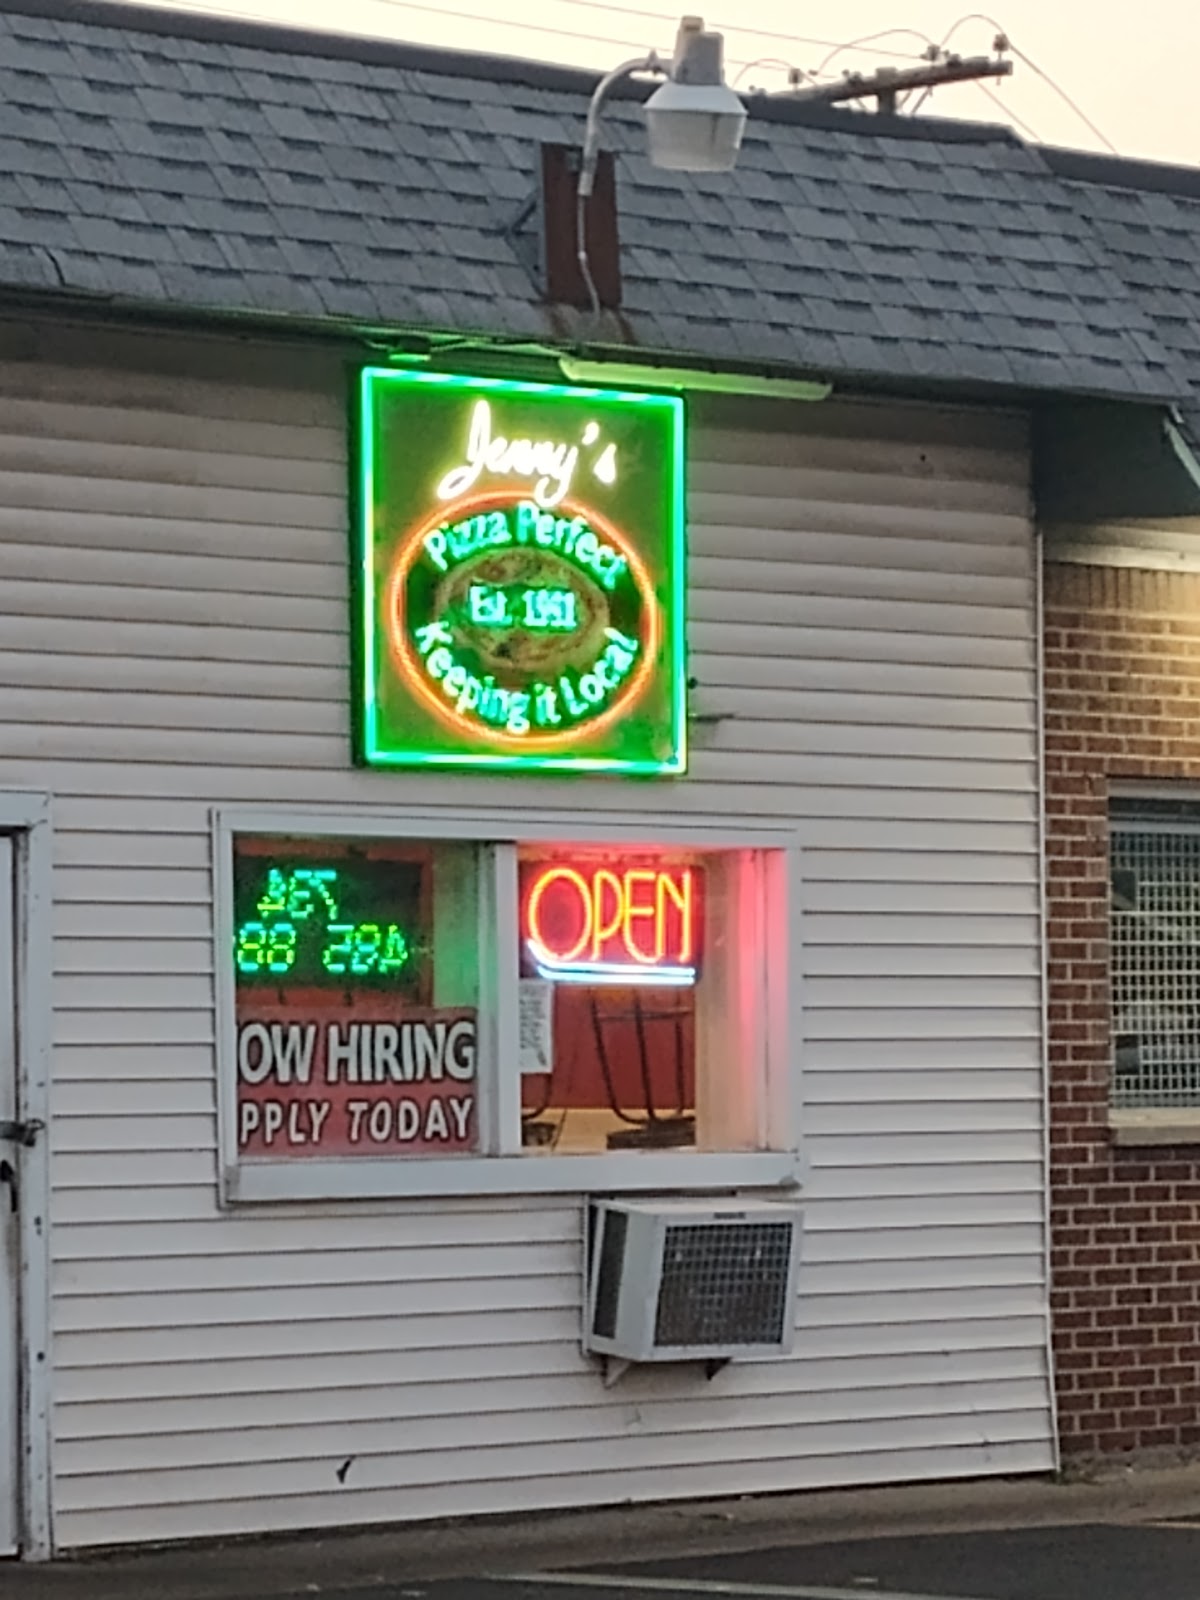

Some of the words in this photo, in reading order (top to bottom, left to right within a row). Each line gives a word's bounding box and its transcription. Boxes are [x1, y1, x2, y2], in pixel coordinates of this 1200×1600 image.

[437, 399, 617, 507] Jenny's
[423, 511, 512, 571] Pizza
[517, 501, 627, 590] Perfect
[415, 621, 531, 734] Keeping
[535, 683, 562, 725] it
[560, 627, 638, 715] Local
[527, 867, 692, 964] OPEN
[237, 1022, 317, 1085] OW
[326, 1020, 477, 1083] HIRING
[239, 1101, 331, 1145] PPLY
[348, 1097, 474, 1142] TODAY
